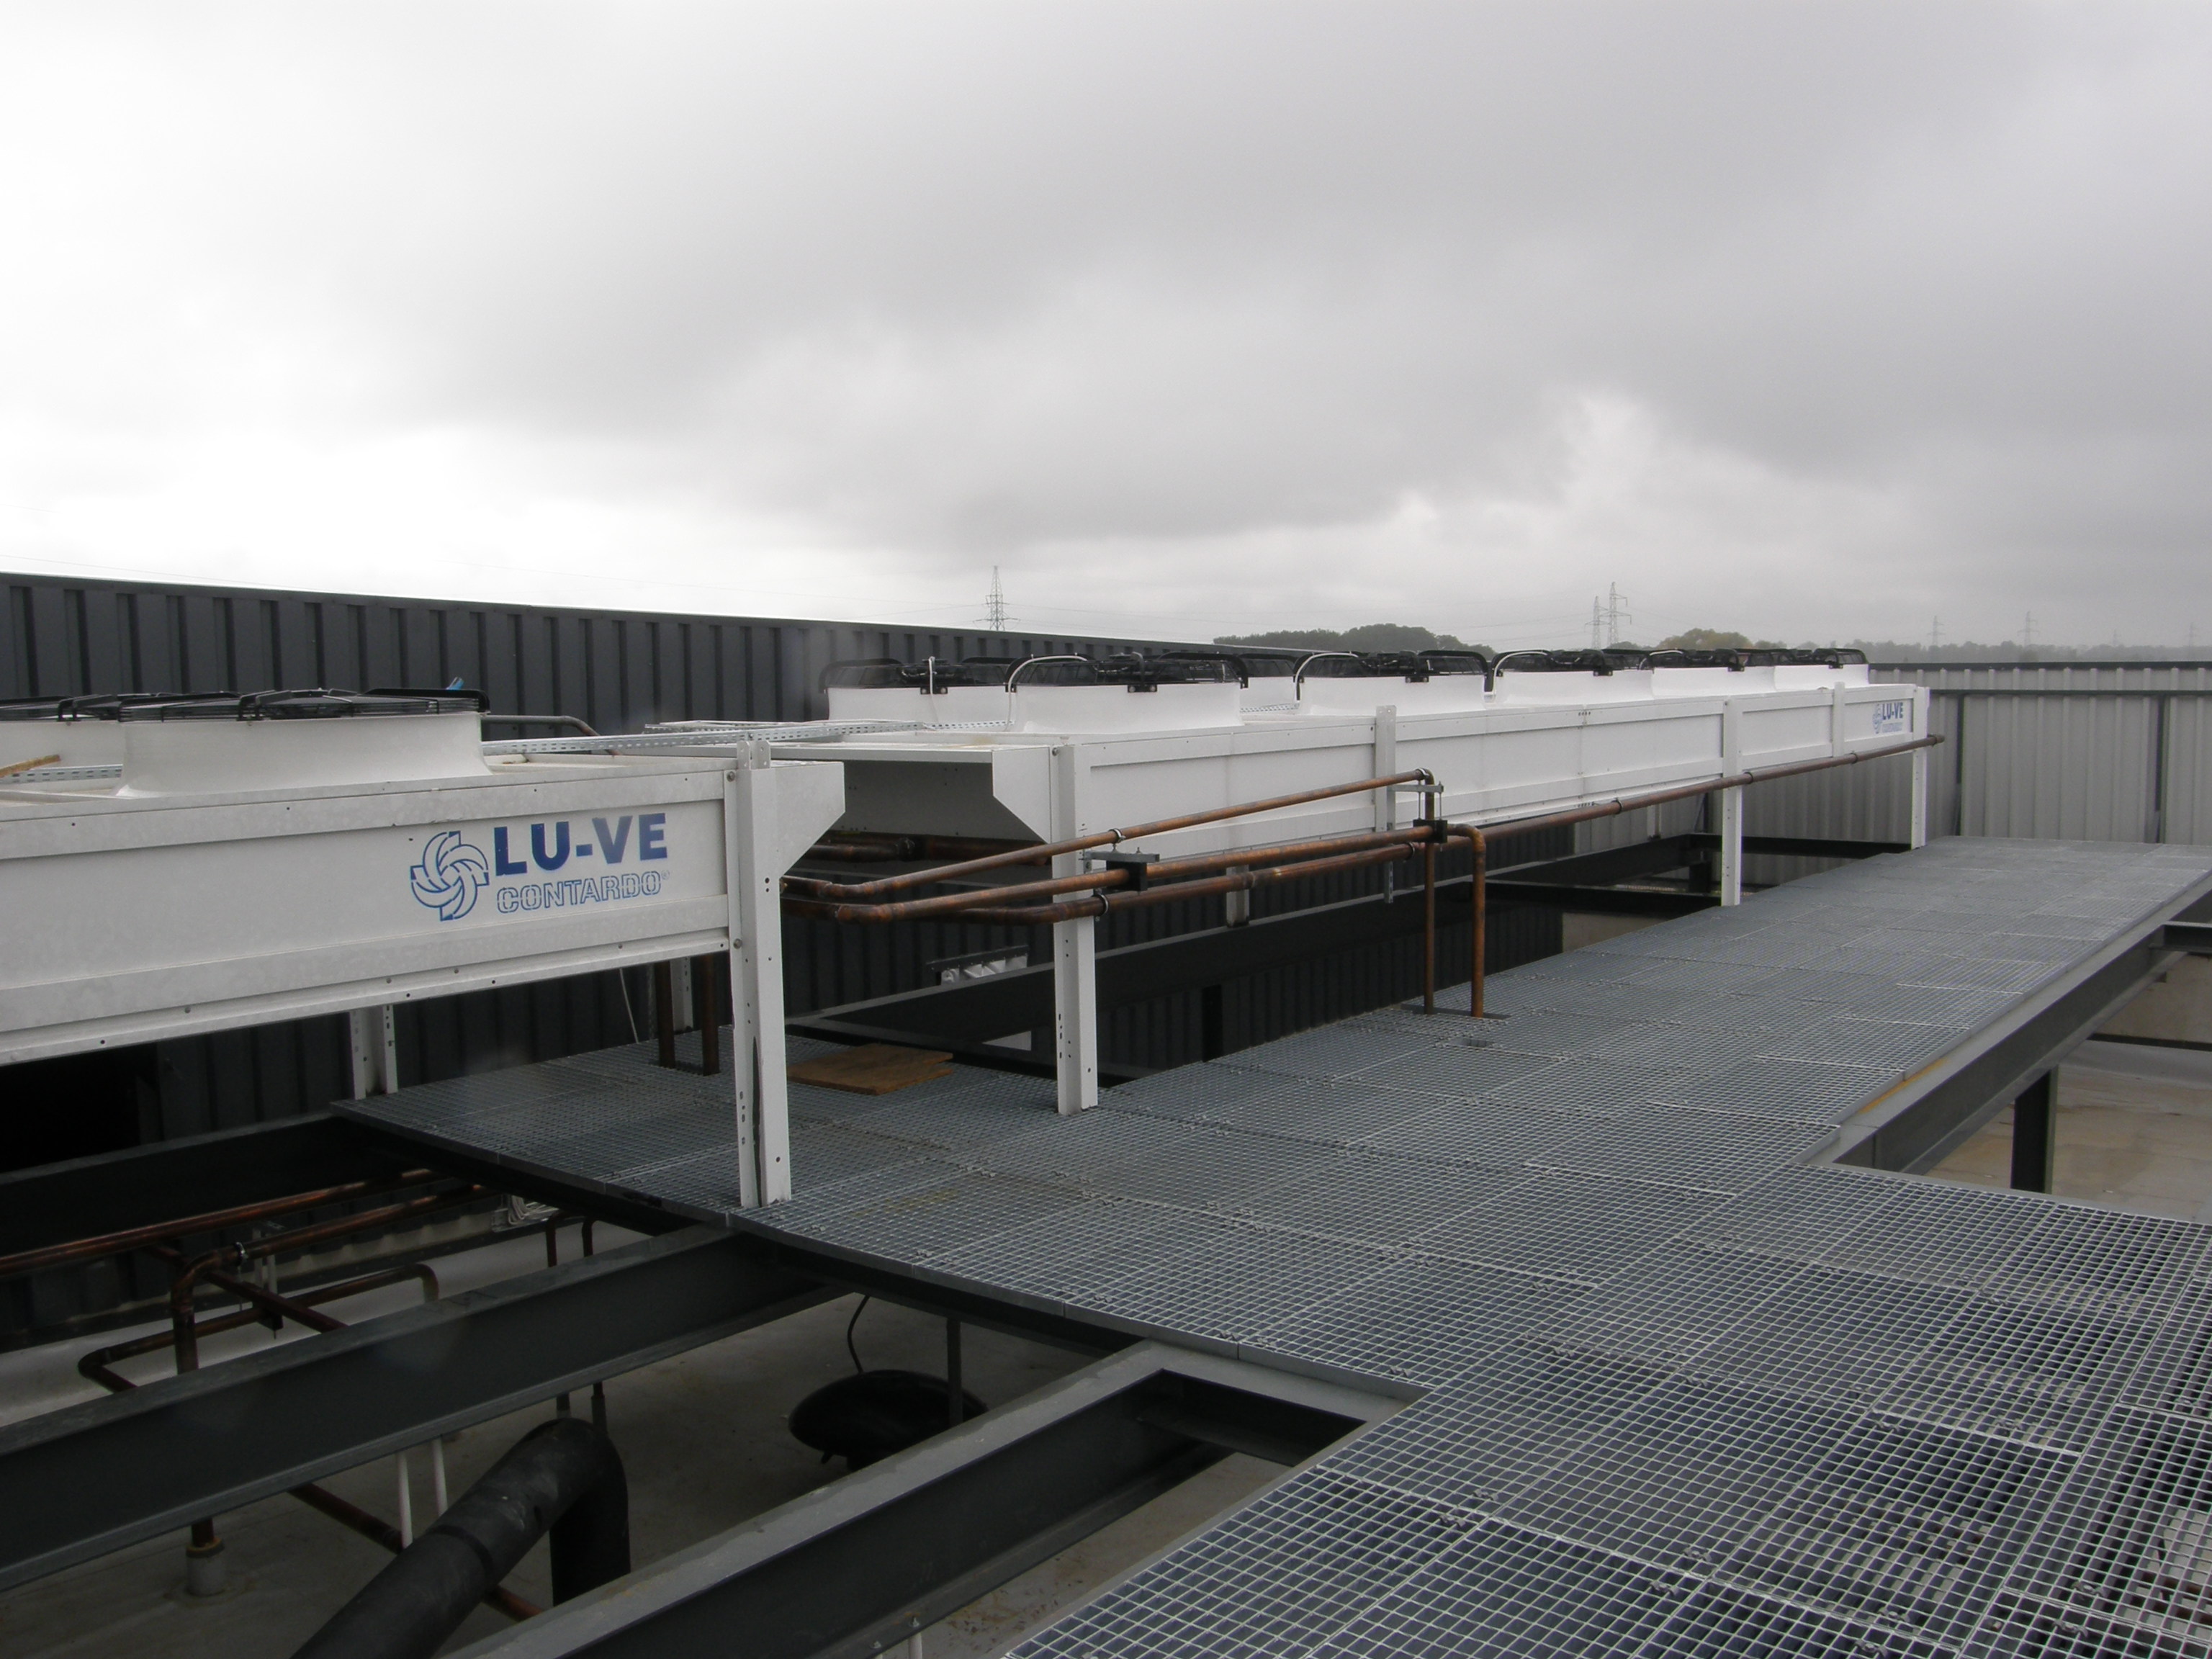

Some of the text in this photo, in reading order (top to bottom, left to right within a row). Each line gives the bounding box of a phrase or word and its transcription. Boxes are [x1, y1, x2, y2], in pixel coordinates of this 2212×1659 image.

[1882, 702, 1903, 720] LU-VE
[493, 813, 667, 876] LU-VE
[497, 871, 662, 914] CONTARDO
